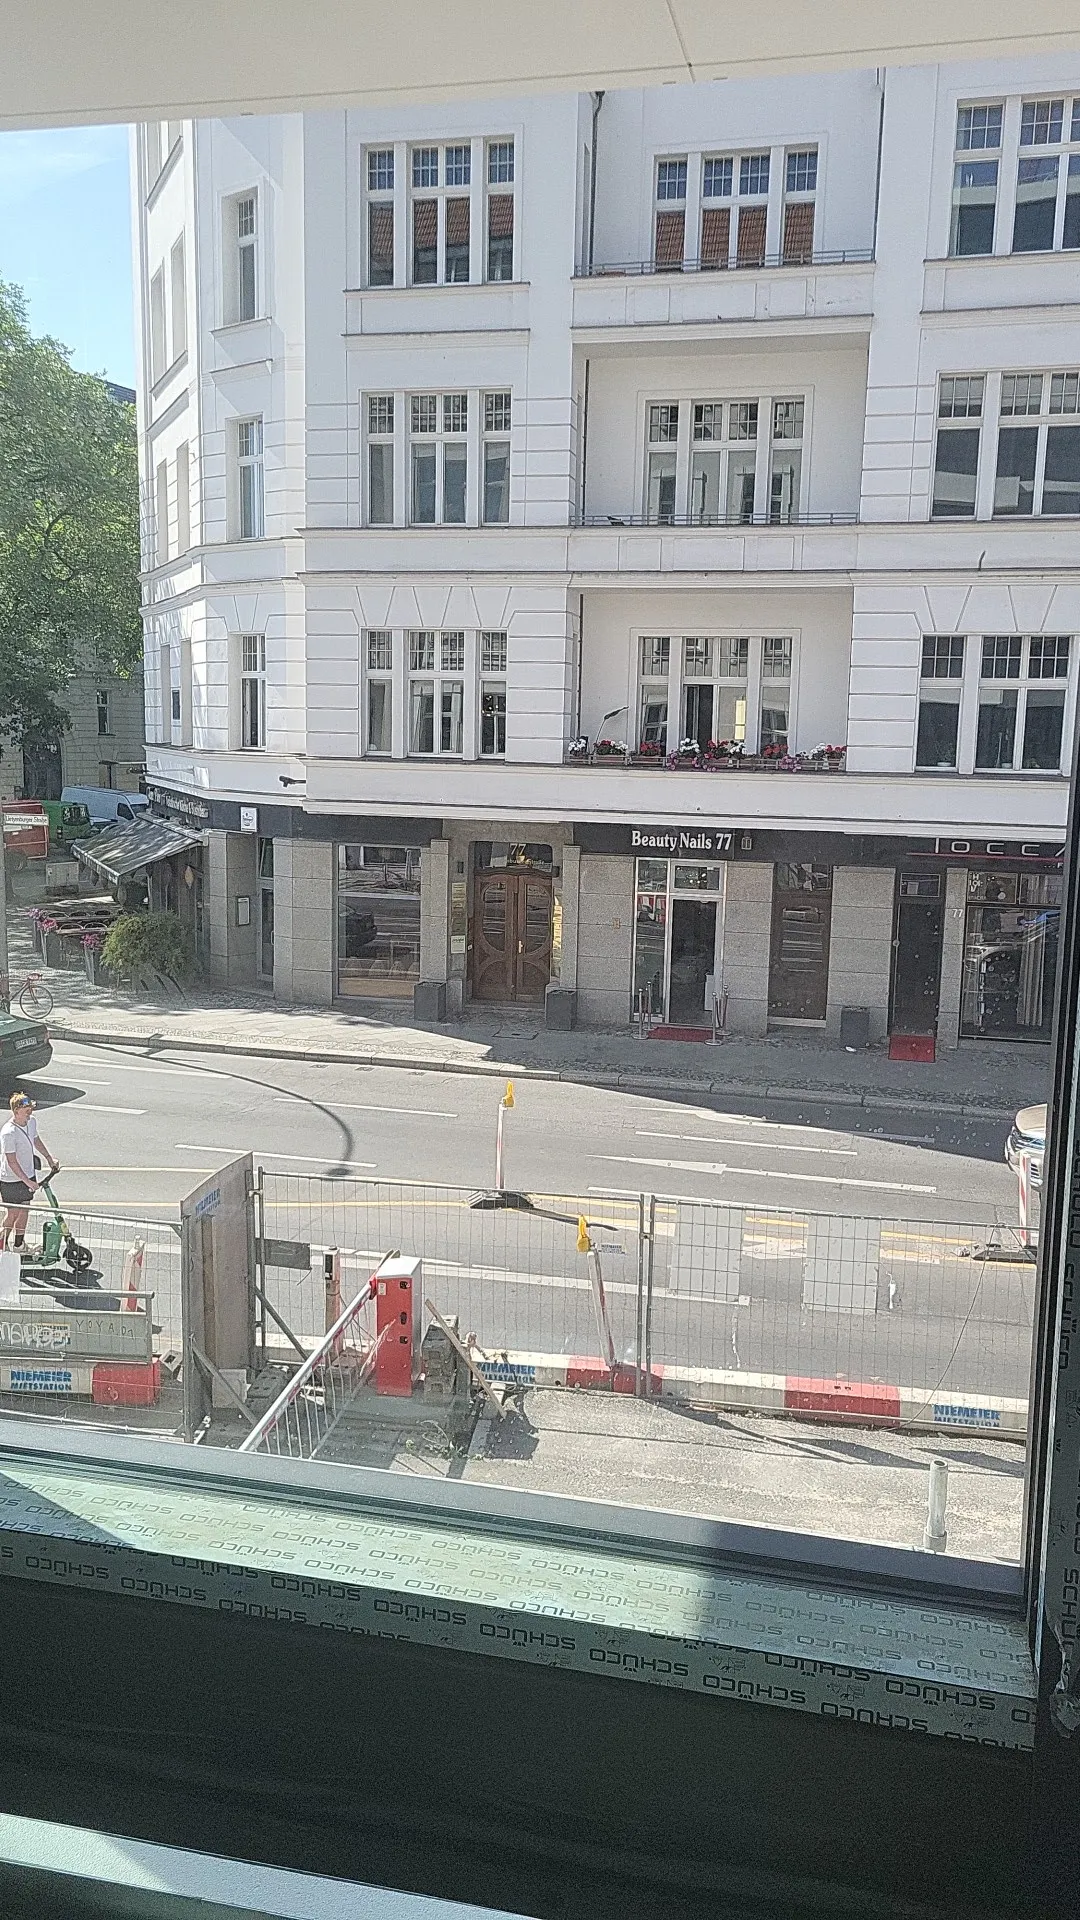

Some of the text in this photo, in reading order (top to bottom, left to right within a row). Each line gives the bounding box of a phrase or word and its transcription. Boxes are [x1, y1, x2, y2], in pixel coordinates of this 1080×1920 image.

[631, 830, 732, 851] Beauty Nails 77
[510, 843, 527, 855] 77
[952, 908, 963, 918] 77
[10, 1370, 72, 1382] NIEMEIER
[933, 1404, 1001, 1420] NIEMEIER
